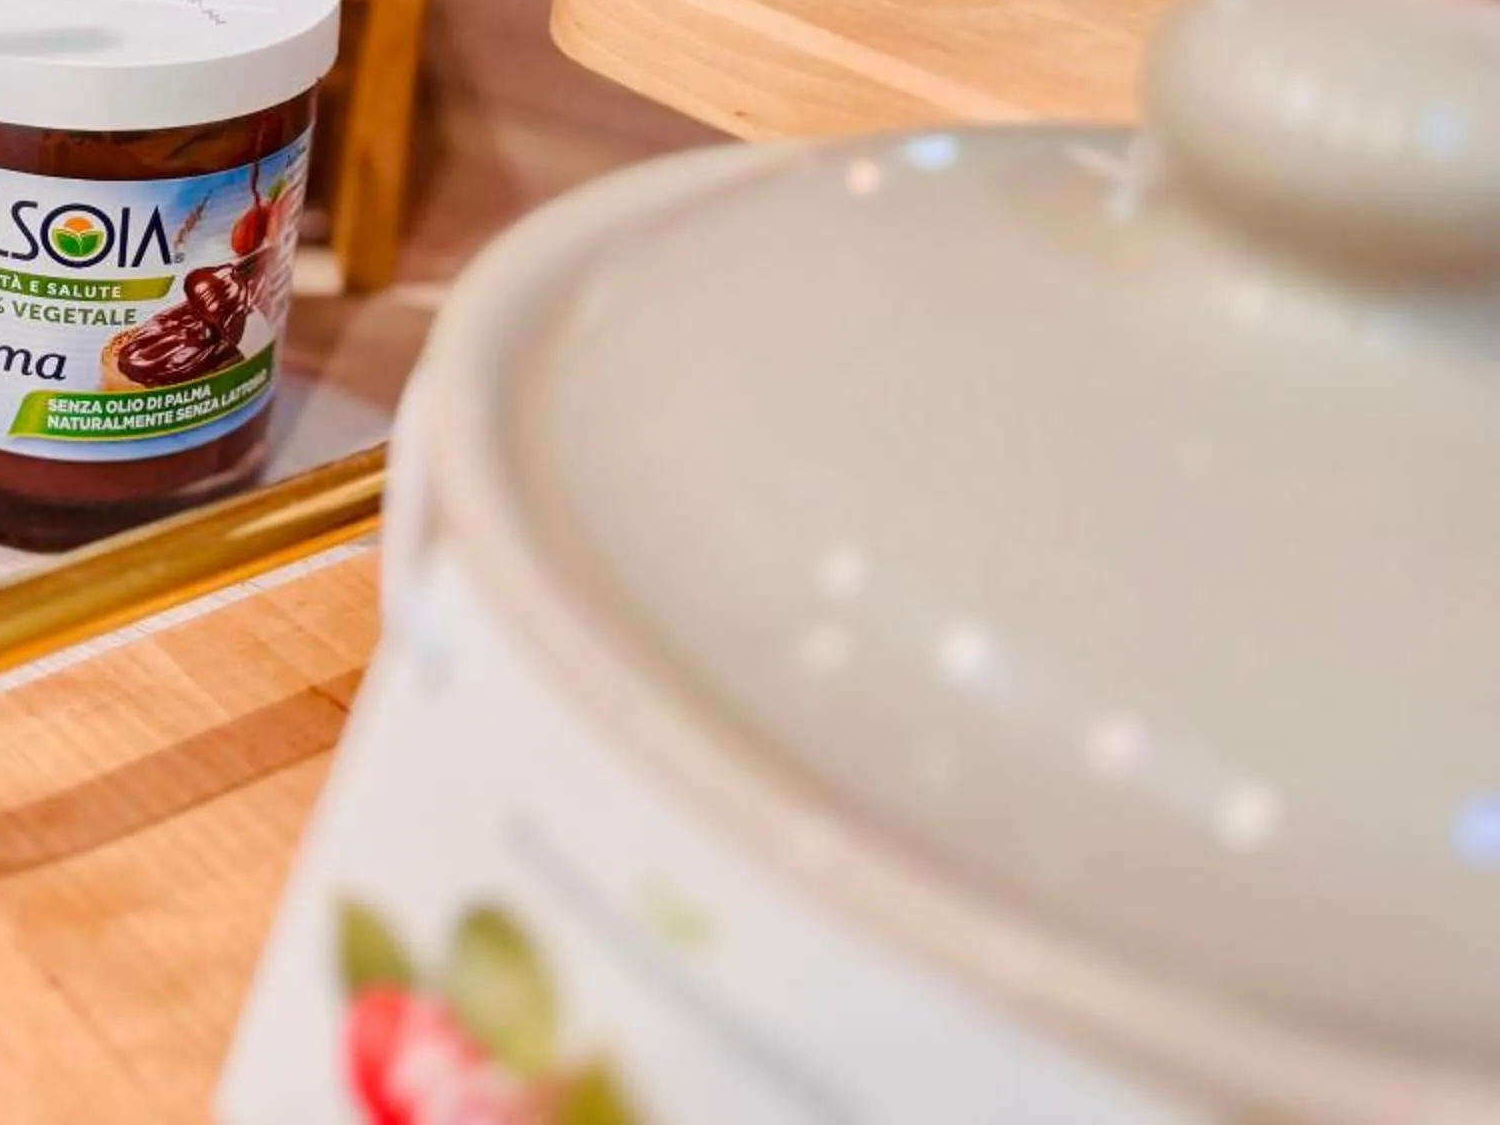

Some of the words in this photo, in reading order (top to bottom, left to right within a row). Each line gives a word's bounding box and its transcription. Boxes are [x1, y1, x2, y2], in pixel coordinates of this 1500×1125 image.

[29, 279, 40, 294] E
[46, 281, 123, 299] SALUTE
[12, 300, 138, 326] VEGETALE
[47, 398, 102, 414] SENZA
[105, 397, 145, 414] OLIO
[147, 396, 164, 411] DI
[164, 384, 213, 409] PALMA
[47, 411, 175, 431] NATURALMENTE
[176, 398, 219, 422] SENZA
